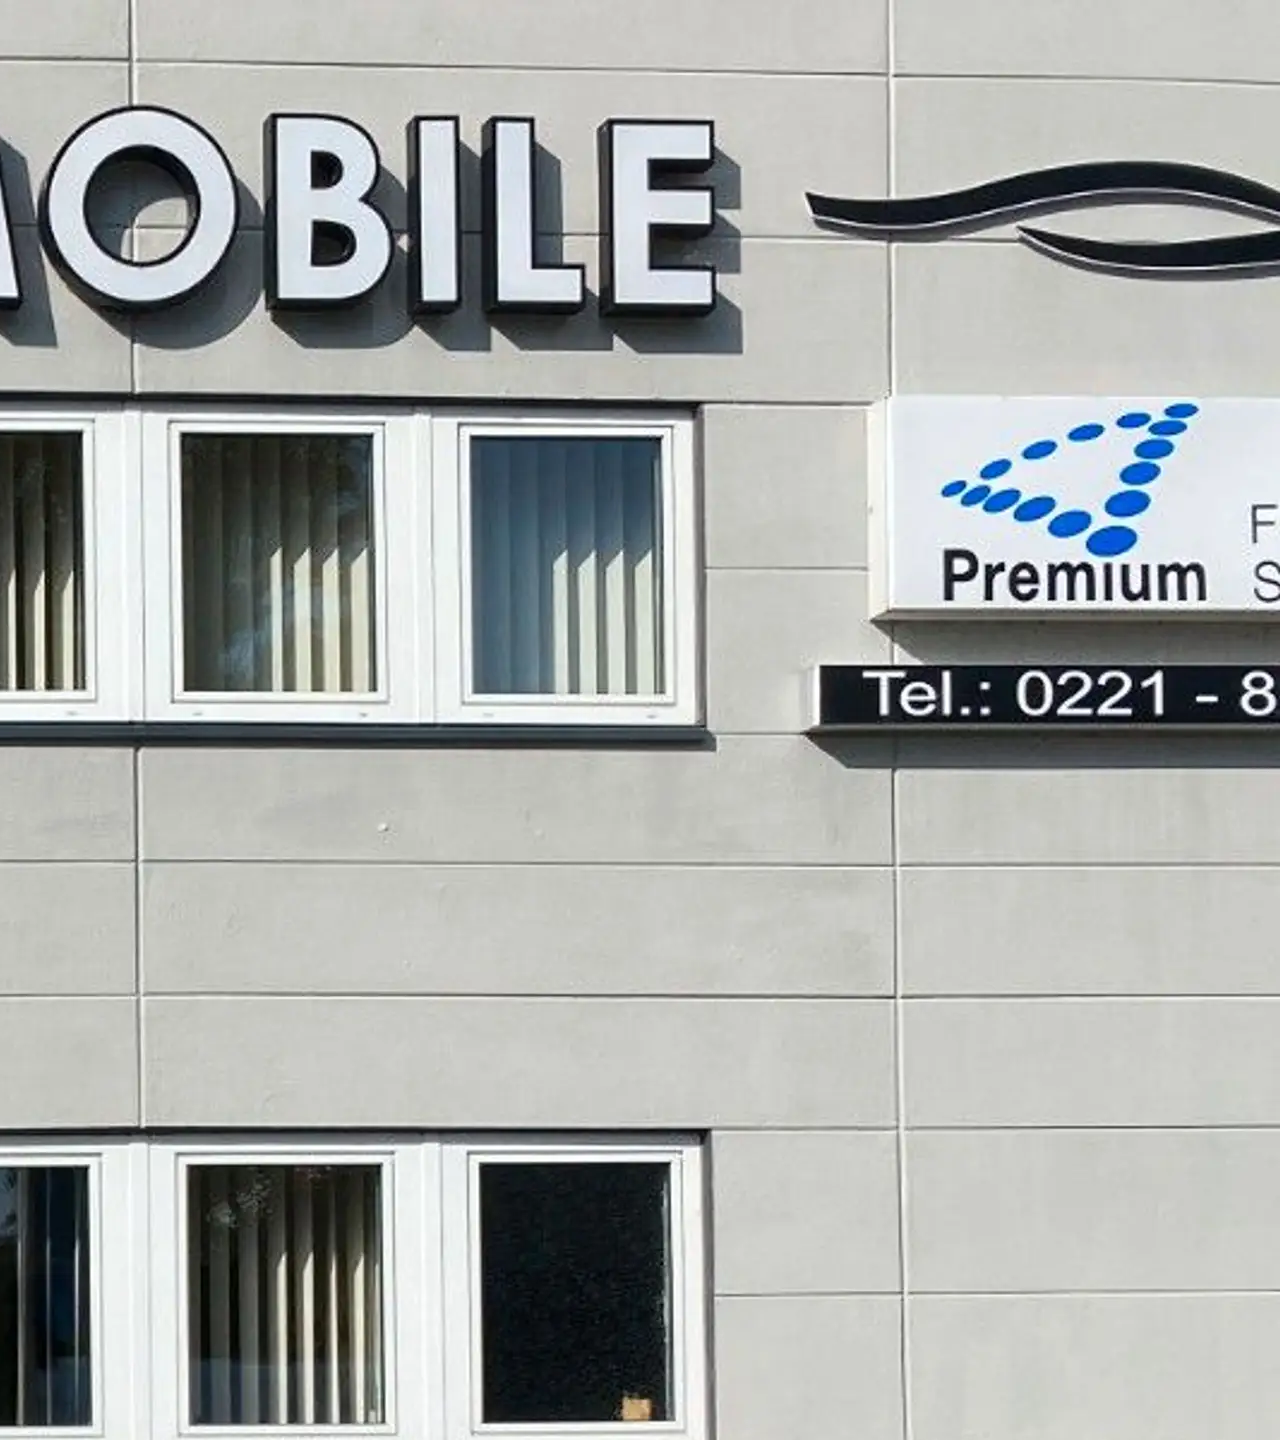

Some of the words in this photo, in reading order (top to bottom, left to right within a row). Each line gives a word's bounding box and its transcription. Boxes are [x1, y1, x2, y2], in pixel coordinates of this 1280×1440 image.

[943, 548, 1207, 601] Premium
[862, 671, 993, 717] Tel.:
[1016, 670, 1165, 717] 0221
[1241, 670, 1277, 717] 8
